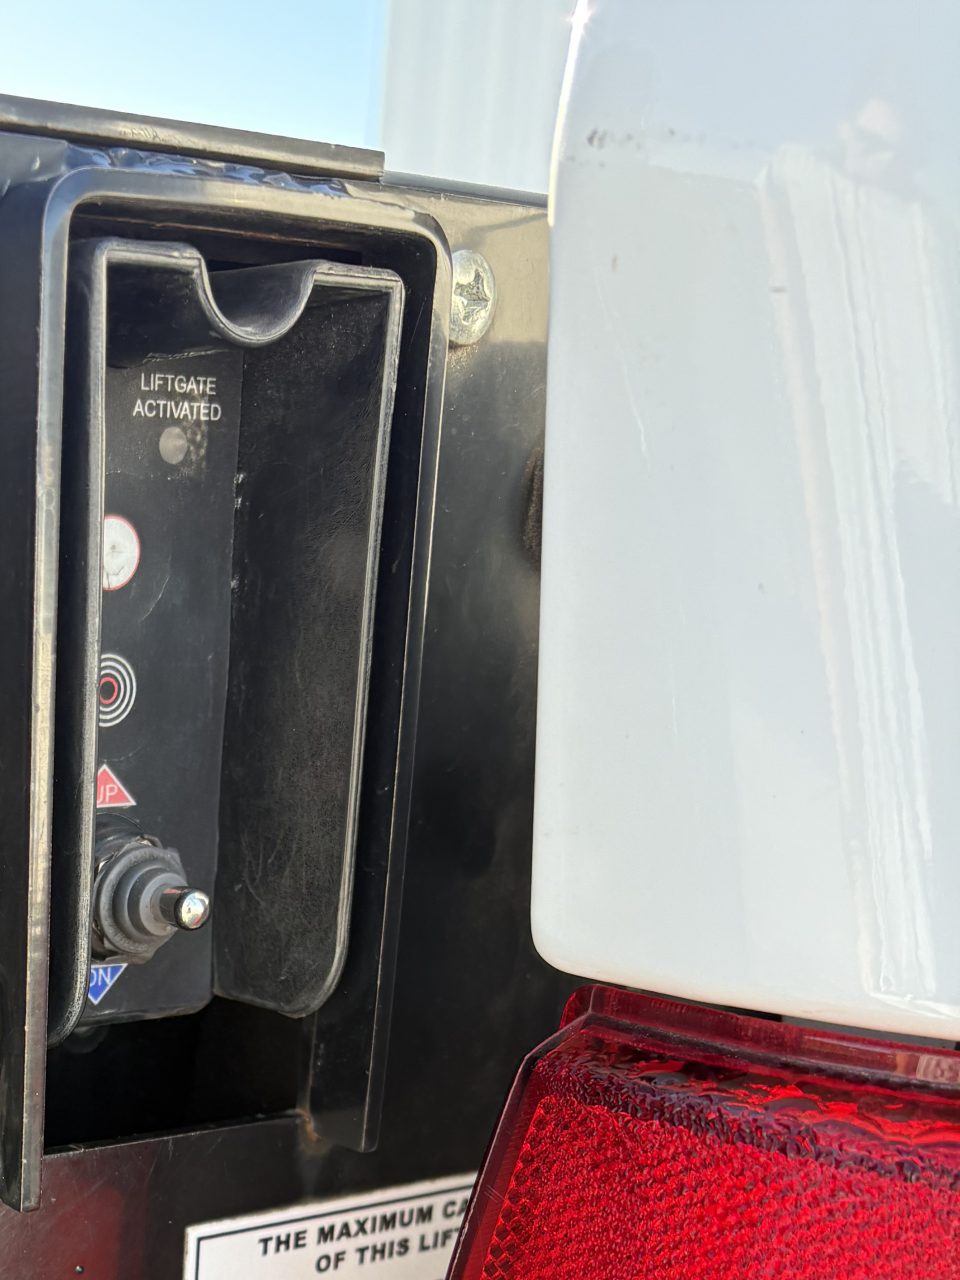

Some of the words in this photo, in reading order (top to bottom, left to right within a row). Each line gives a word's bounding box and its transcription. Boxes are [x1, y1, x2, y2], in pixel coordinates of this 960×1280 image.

[140, 373, 218, 396] LIFTGATE
[132, 399, 222, 422] ACTIVATED
[258, 1229, 308, 1257] THE
[316, 1203, 434, 1246] MAXIMUM
[315, 1251, 347, 1274] OF
[357, 1239, 410, 1266] THIS
[418, 1227, 460, 1252] LIF
